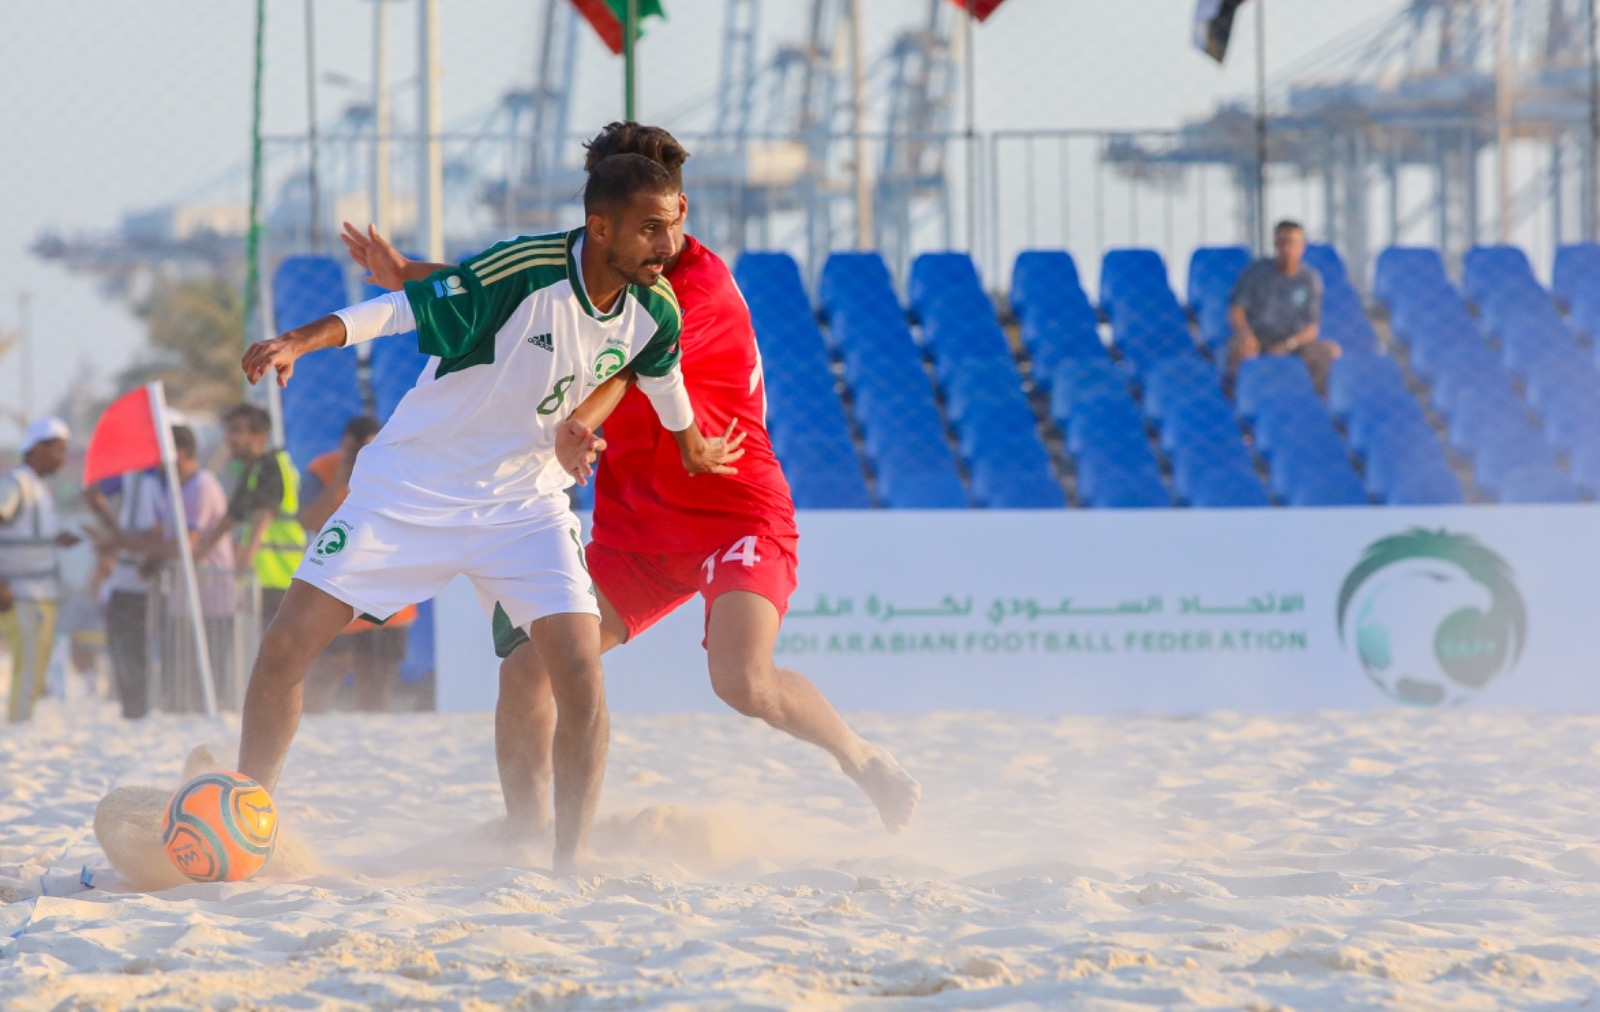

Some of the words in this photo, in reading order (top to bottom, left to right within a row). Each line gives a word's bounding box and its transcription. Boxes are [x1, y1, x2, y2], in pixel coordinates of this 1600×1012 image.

[536, 375, 575, 415] 8
[701, 535, 761, 584] 14
[786, 593, 855, 617] الق
[774, 634, 818, 653] UDI
[826, 633, 958, 653] ARABIAN
[964, 632, 1116, 653] FOOTBALL
[1124, 631, 1308, 652] FEDERATION
